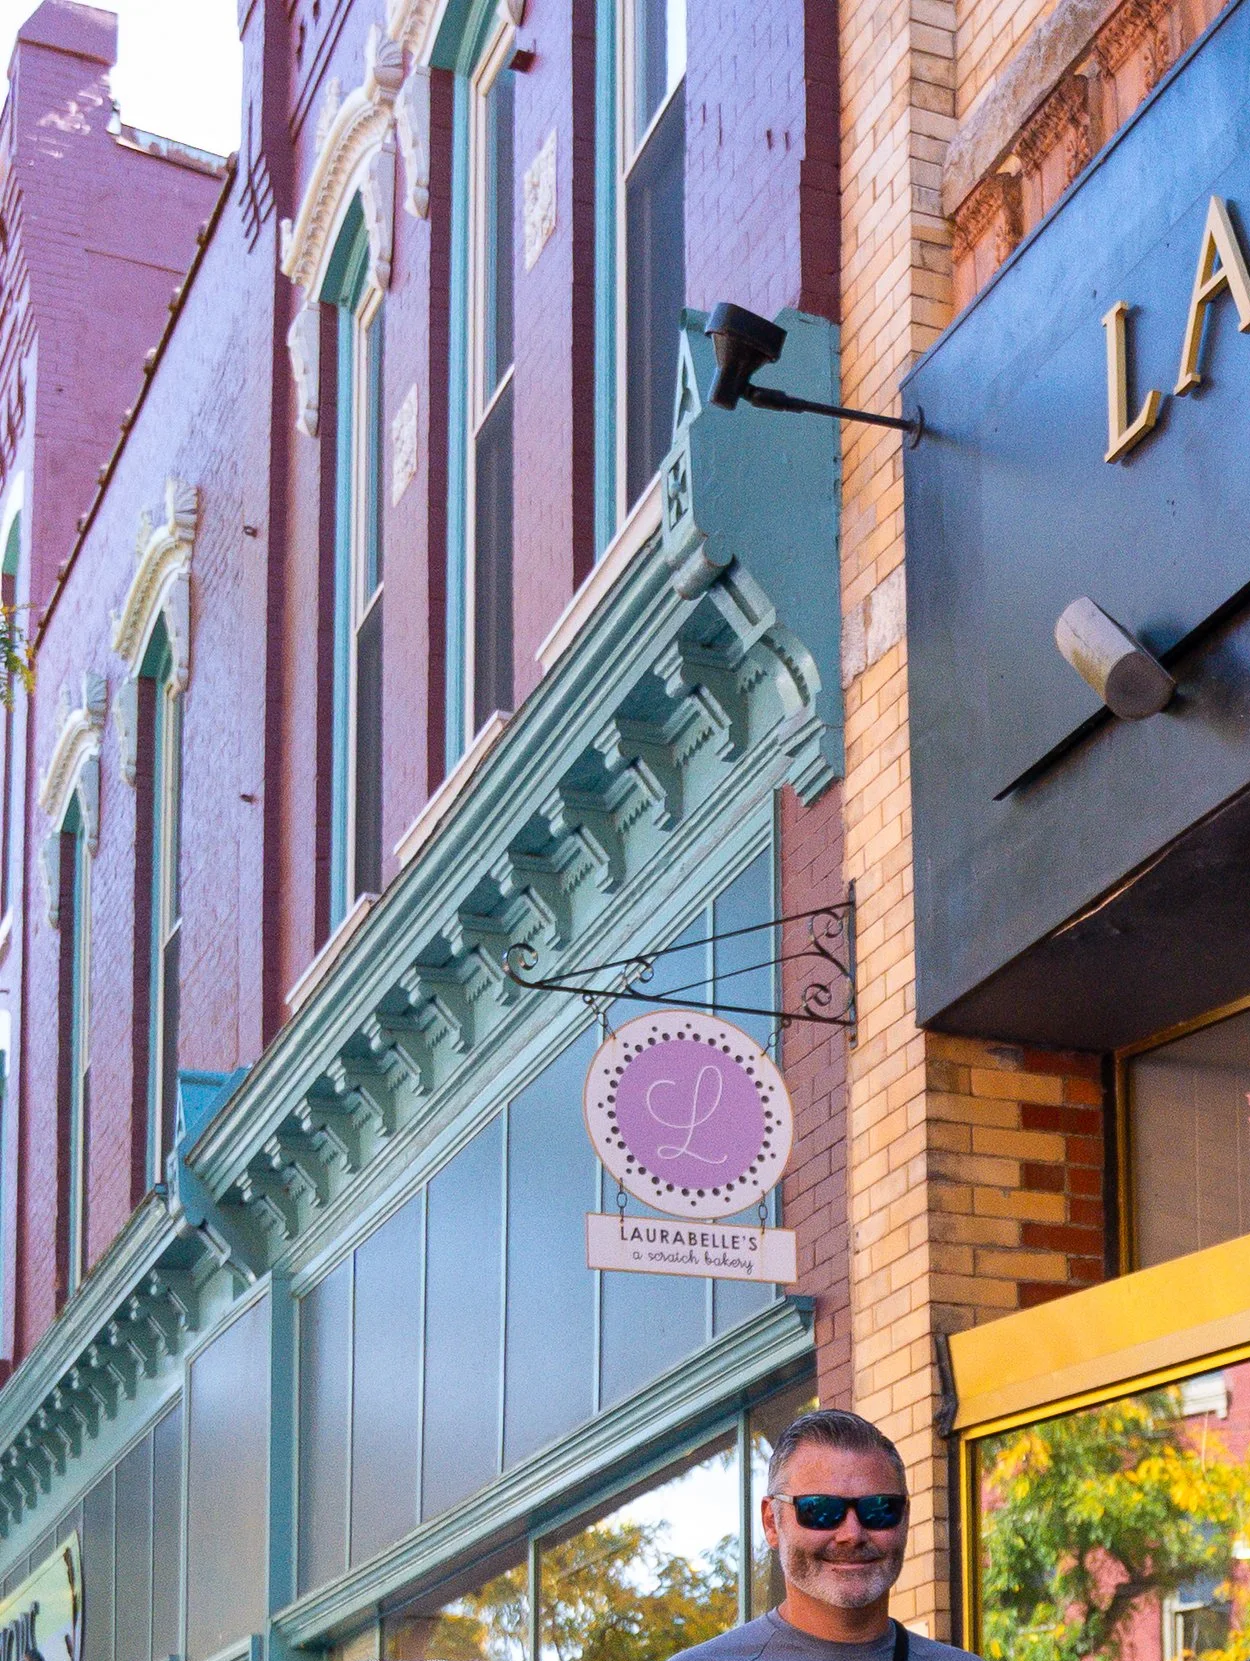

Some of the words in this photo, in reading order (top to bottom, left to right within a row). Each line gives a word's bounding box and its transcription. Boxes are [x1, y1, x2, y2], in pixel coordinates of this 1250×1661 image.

[620, 1226, 758, 1251] LAURABELLE'S
[632, 1250, 643, 1261] a
[648, 1249, 700, 1265] scratch
[704, 1251, 754, 1275] bakery
